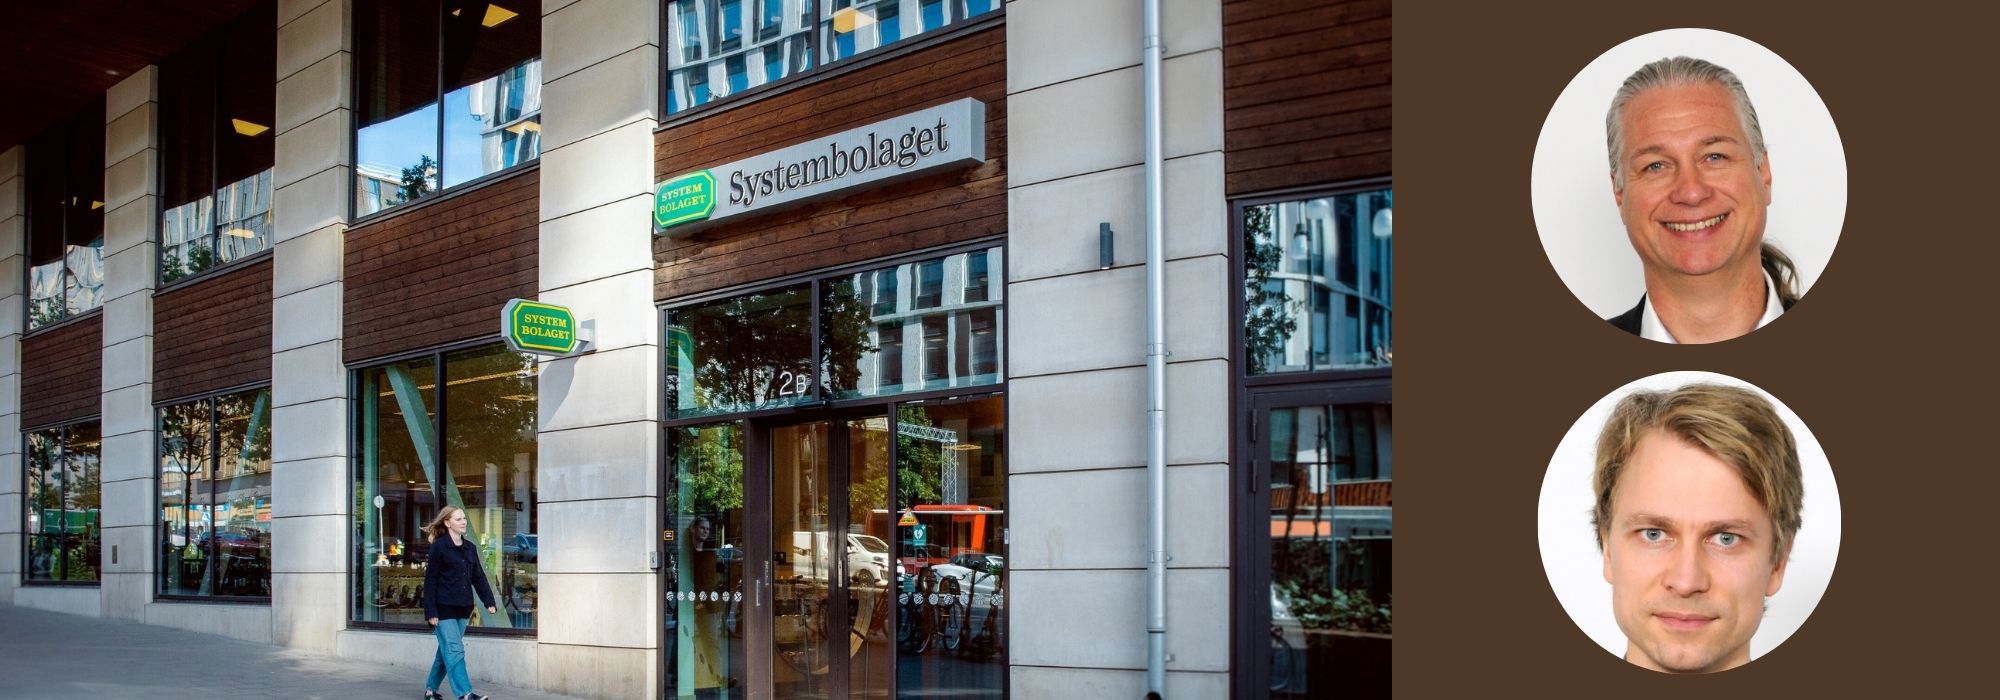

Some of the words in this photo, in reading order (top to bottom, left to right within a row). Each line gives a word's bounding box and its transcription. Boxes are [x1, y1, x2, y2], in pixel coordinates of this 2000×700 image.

[729, 117, 949, 206] Systembolaget
[661, 183, 703, 202] SYSTEM
[659, 194, 706, 214] BOLAGET
[524, 313, 567, 328] SYSTEM
[521, 325, 570, 340] BOLAGET
[779, 371, 807, 395] 2B
